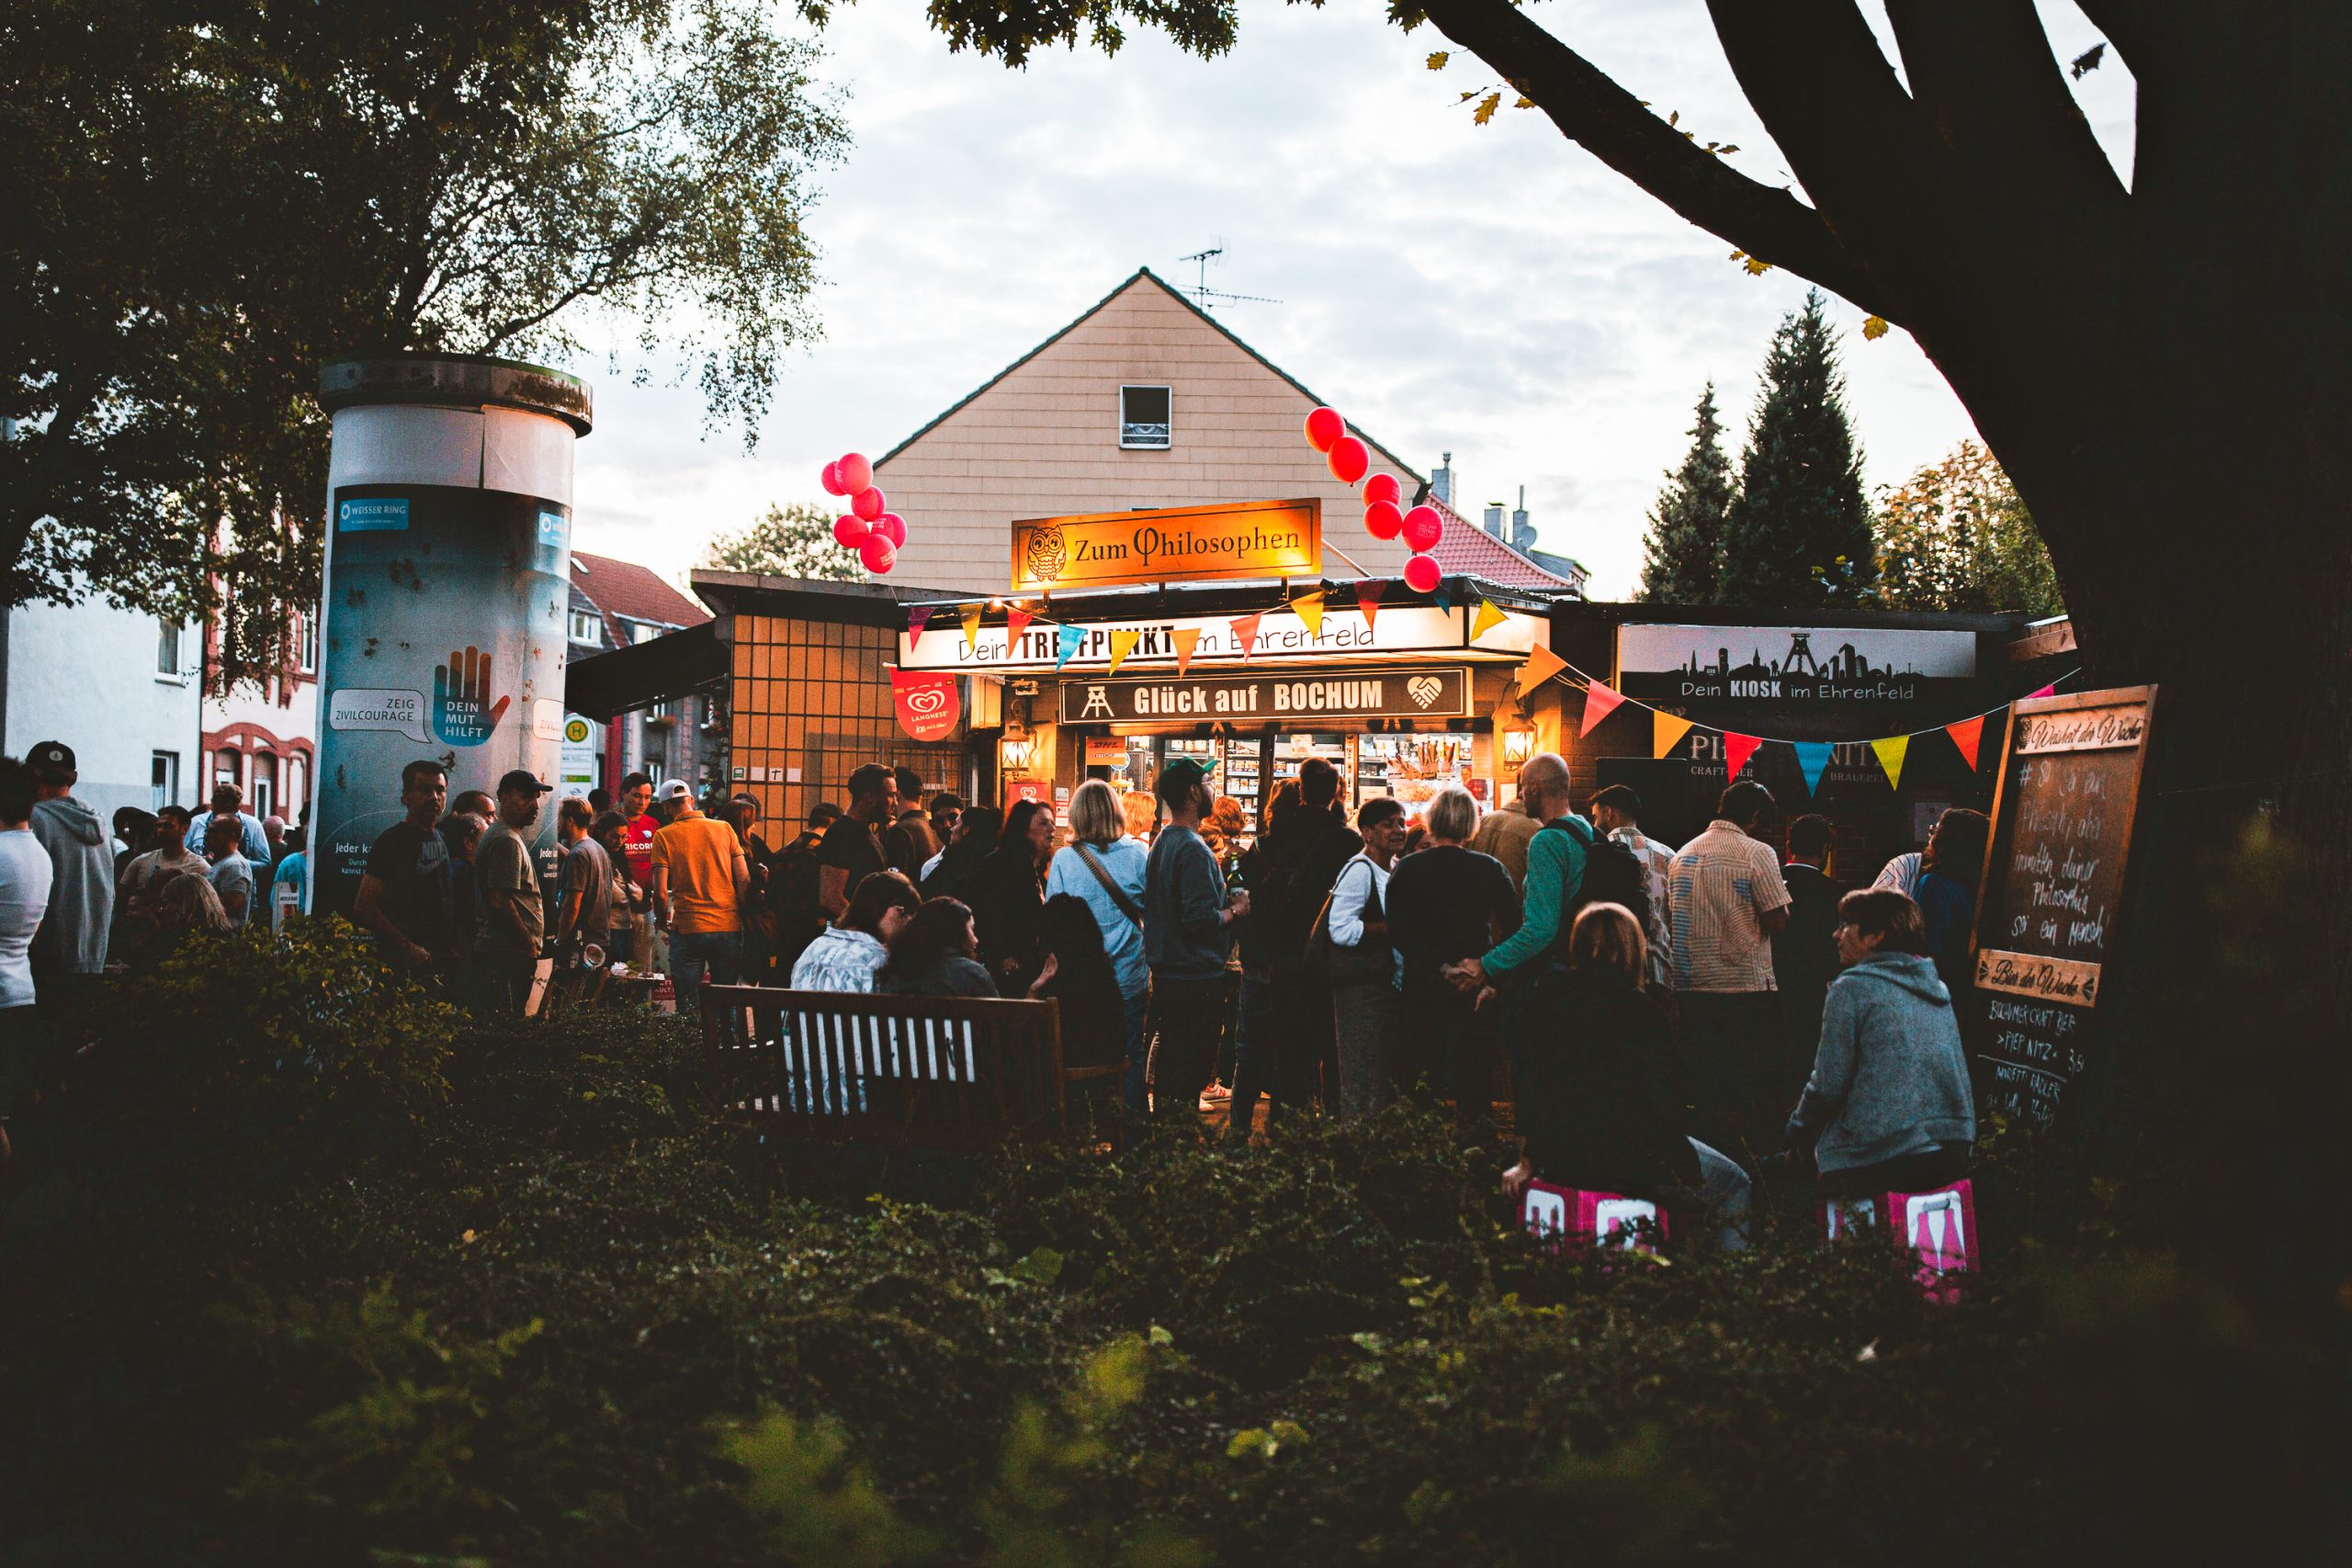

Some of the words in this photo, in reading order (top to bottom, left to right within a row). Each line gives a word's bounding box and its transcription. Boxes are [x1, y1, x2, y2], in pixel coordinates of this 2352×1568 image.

[351, 506, 382, 515] WEISSER
[383, 505, 406, 514] RING
[1075, 540, 1127, 561] Zum
[958, 638, 1008, 660] Dein
[1681, 682, 1721, 696] Dein
[1730, 680, 1781, 698] KIOSK
[1792, 685, 1810, 698] im
[1819, 682, 1914, 700] Ehrenfeld
[387, 698, 414, 708] ZEIG
[1134, 685, 1208, 714] Glück
[1215, 684, 1258, 712] auf
[1274, 681, 1383, 711] BOCHUM
[447, 701, 479, 712] DEIN
[335, 710, 414, 722] ZIVILCOURAGE
[445, 715, 475, 725] MUT
[911, 711, 948, 722] LANGNESE
[445, 727, 482, 738] HILFT
[335, 841, 359, 853] Jeder
